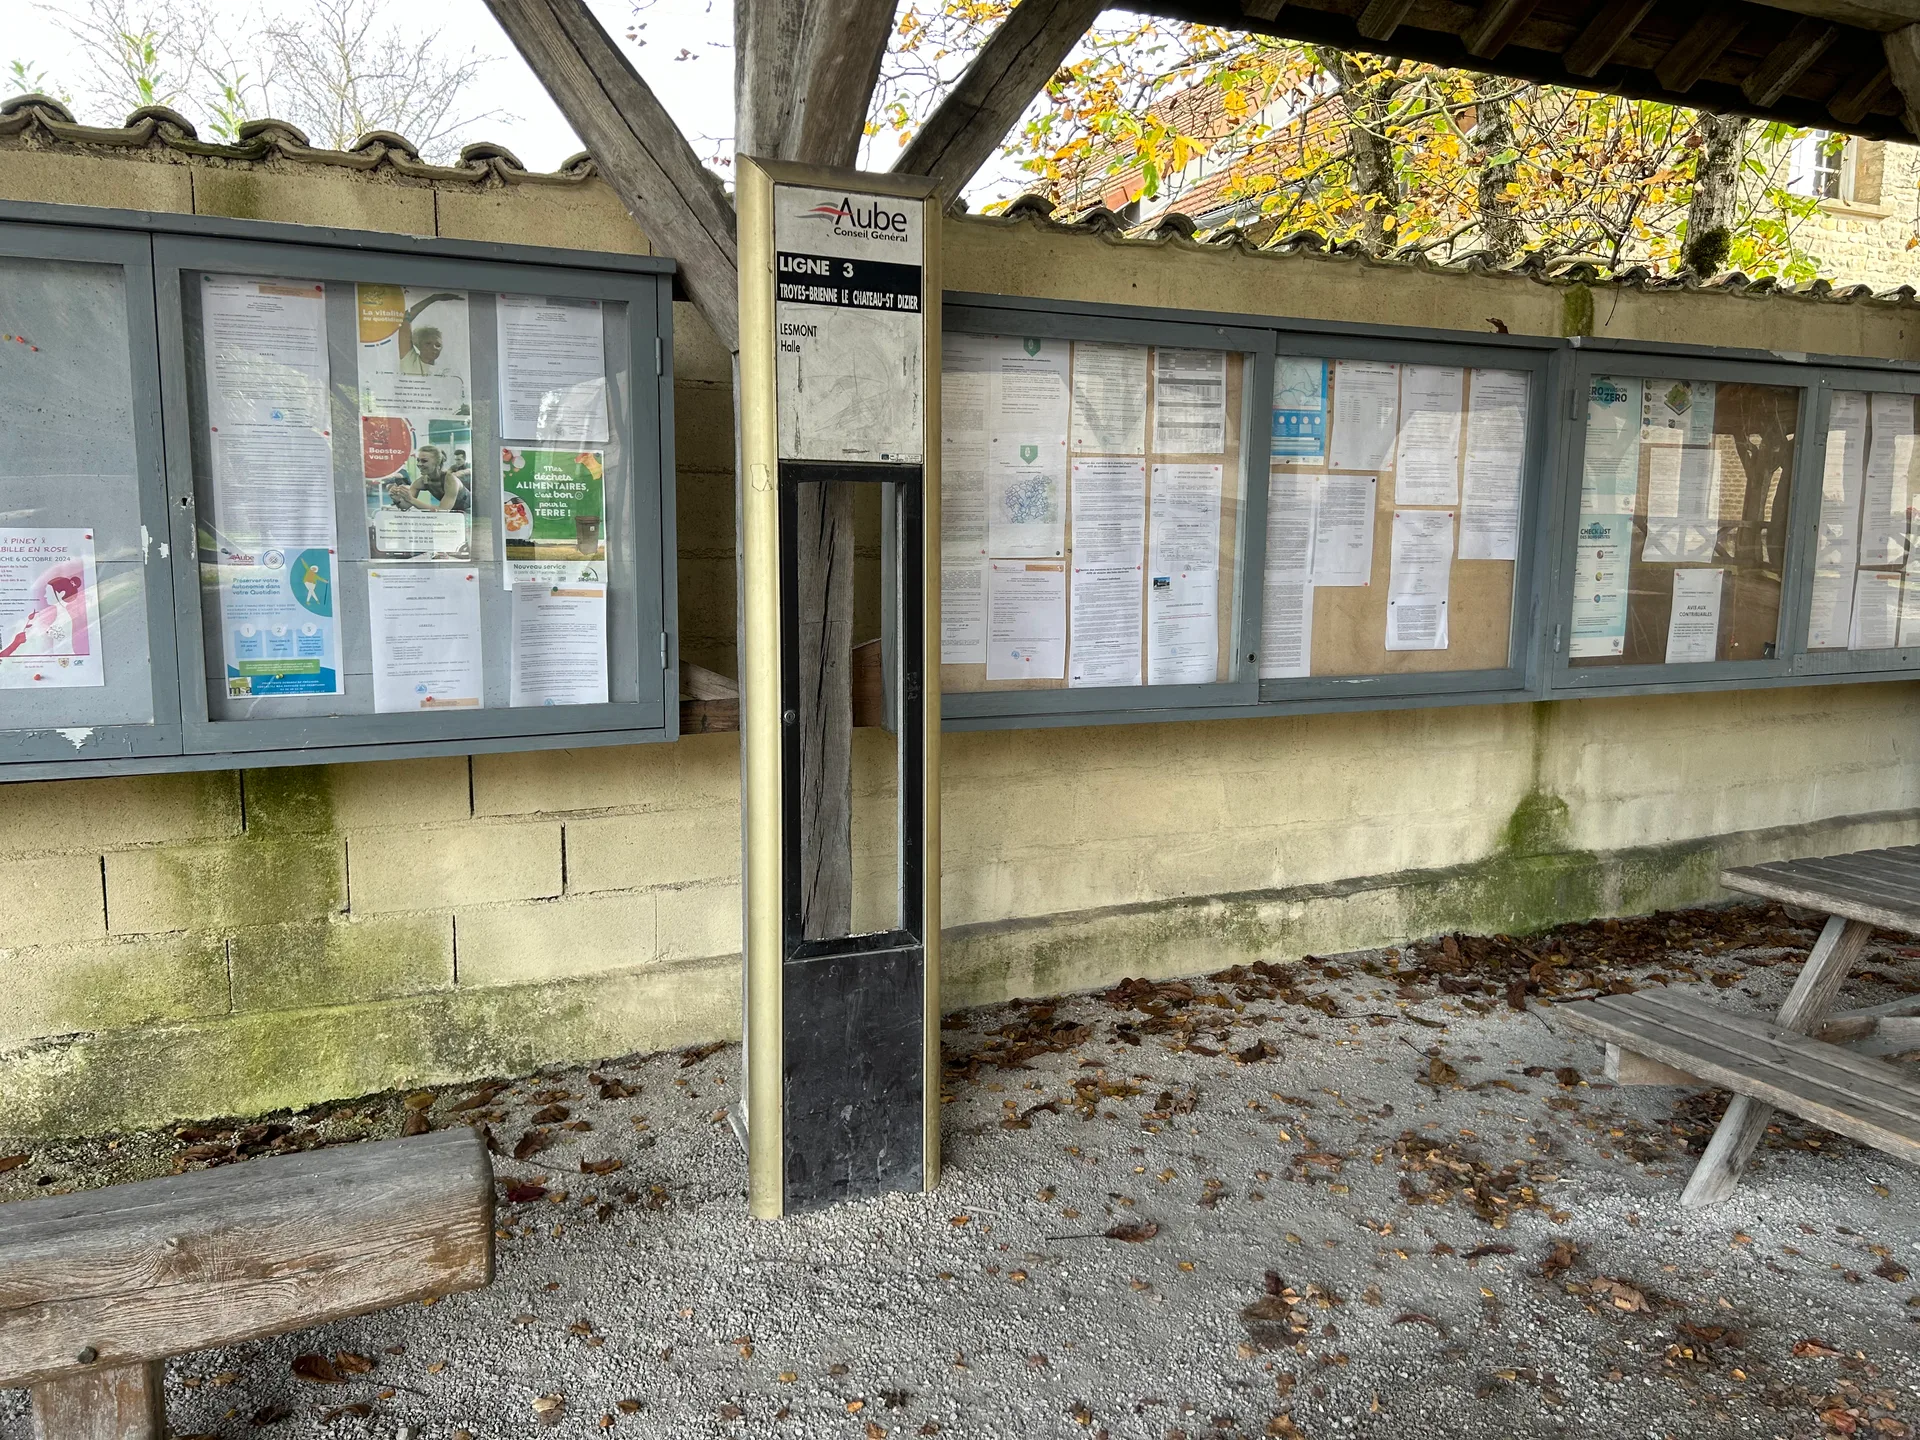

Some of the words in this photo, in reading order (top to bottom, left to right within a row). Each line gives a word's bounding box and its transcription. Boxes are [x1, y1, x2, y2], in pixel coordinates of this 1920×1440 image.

[835, 197, 907, 233] Aube
[834, 227, 869, 239] Conseil
[871, 231, 908, 242] Général
[779, 255, 830, 276] LIGNE
[842, 262, 854, 278] 3
[779, 283, 838, 303] TROYES-BRIENNE
[841, 289, 849, 304] LE
[852, 290, 894, 308] CHATEAU-ST
[897, 294, 918, 310] DIZIER
[780, 323, 818, 338] LESMONT
[780, 340, 801, 353] Halle
[1603, 393, 1628, 403] ZERO
[534, 472, 574, 481] déchets
[516, 481, 589, 492] ALIMENTAIRES,
[553, 490, 574, 499] bon
[535, 508, 566, 517] TERRE
[235, 553, 255, 561] Aube
